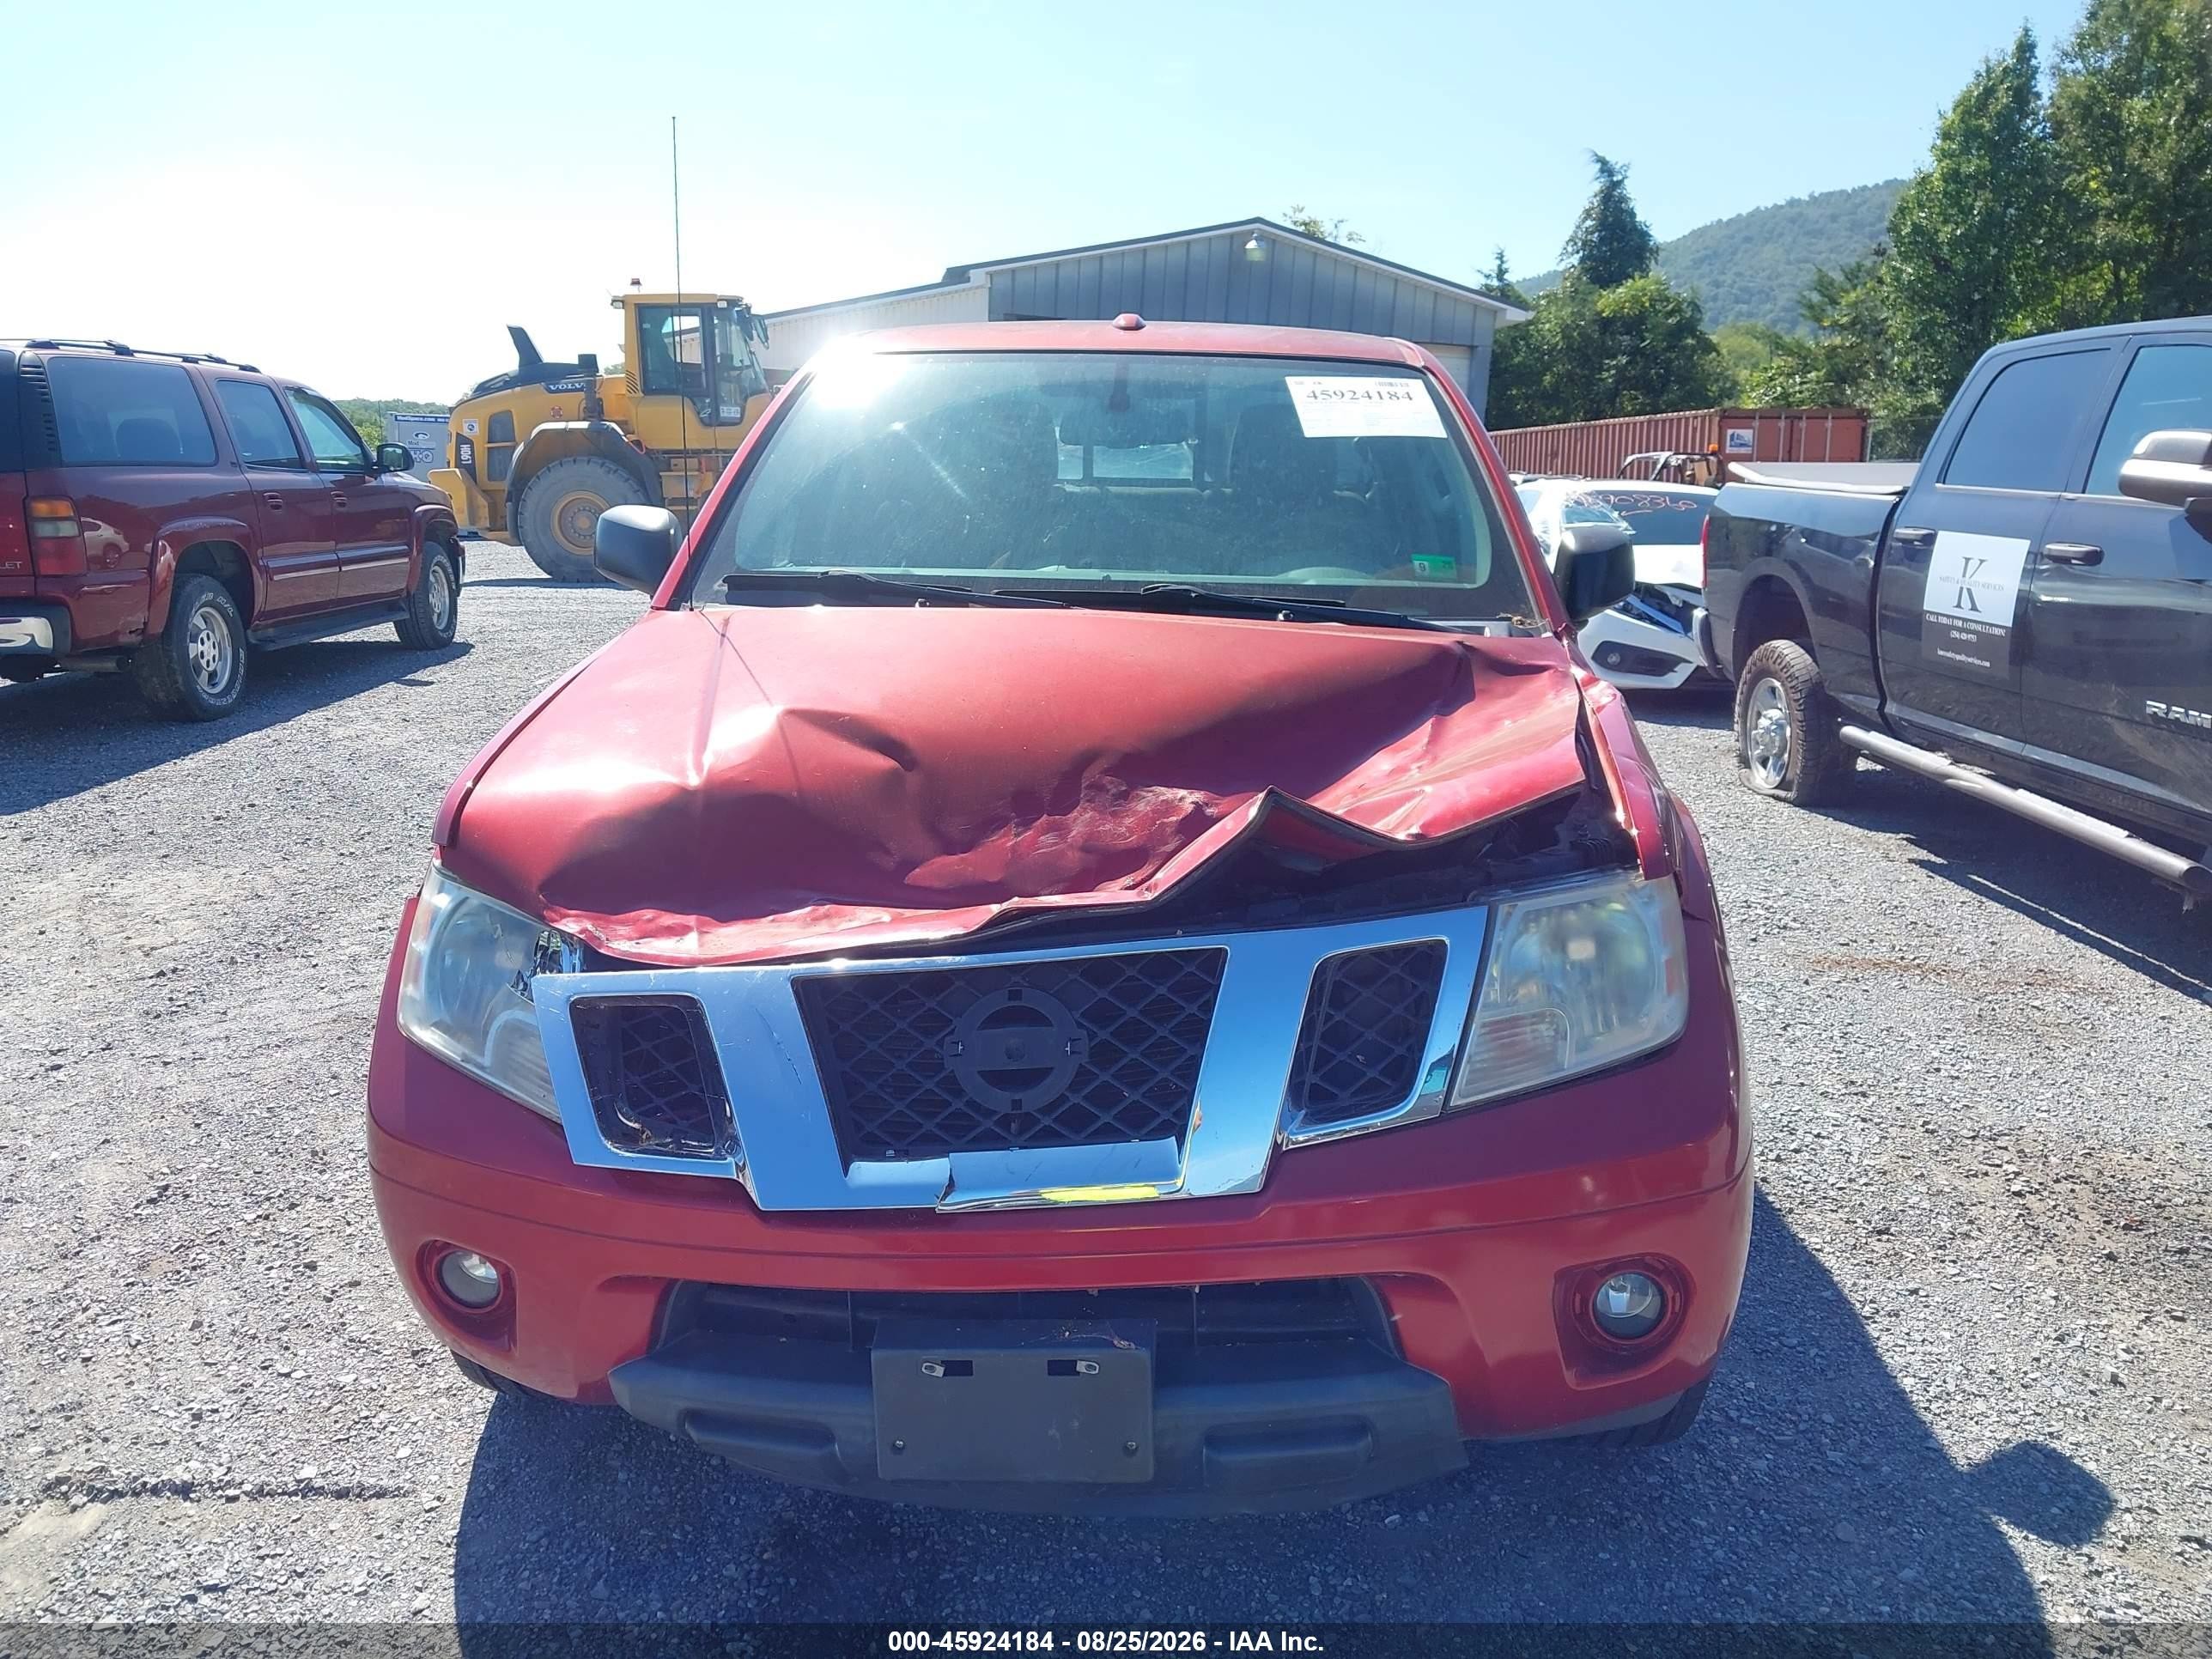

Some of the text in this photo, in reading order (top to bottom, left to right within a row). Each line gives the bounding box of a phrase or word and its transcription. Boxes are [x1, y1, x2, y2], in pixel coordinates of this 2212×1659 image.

[1306, 389, 1413, 401] 45924184
[459, 444, 471, 465] L90H
[1419, 562, 1426, 571] 9
[1926, 613, 1937, 623] CALL
[1938, 616, 1953, 625] TODAY
[1953, 618, 1964, 628] FOR
